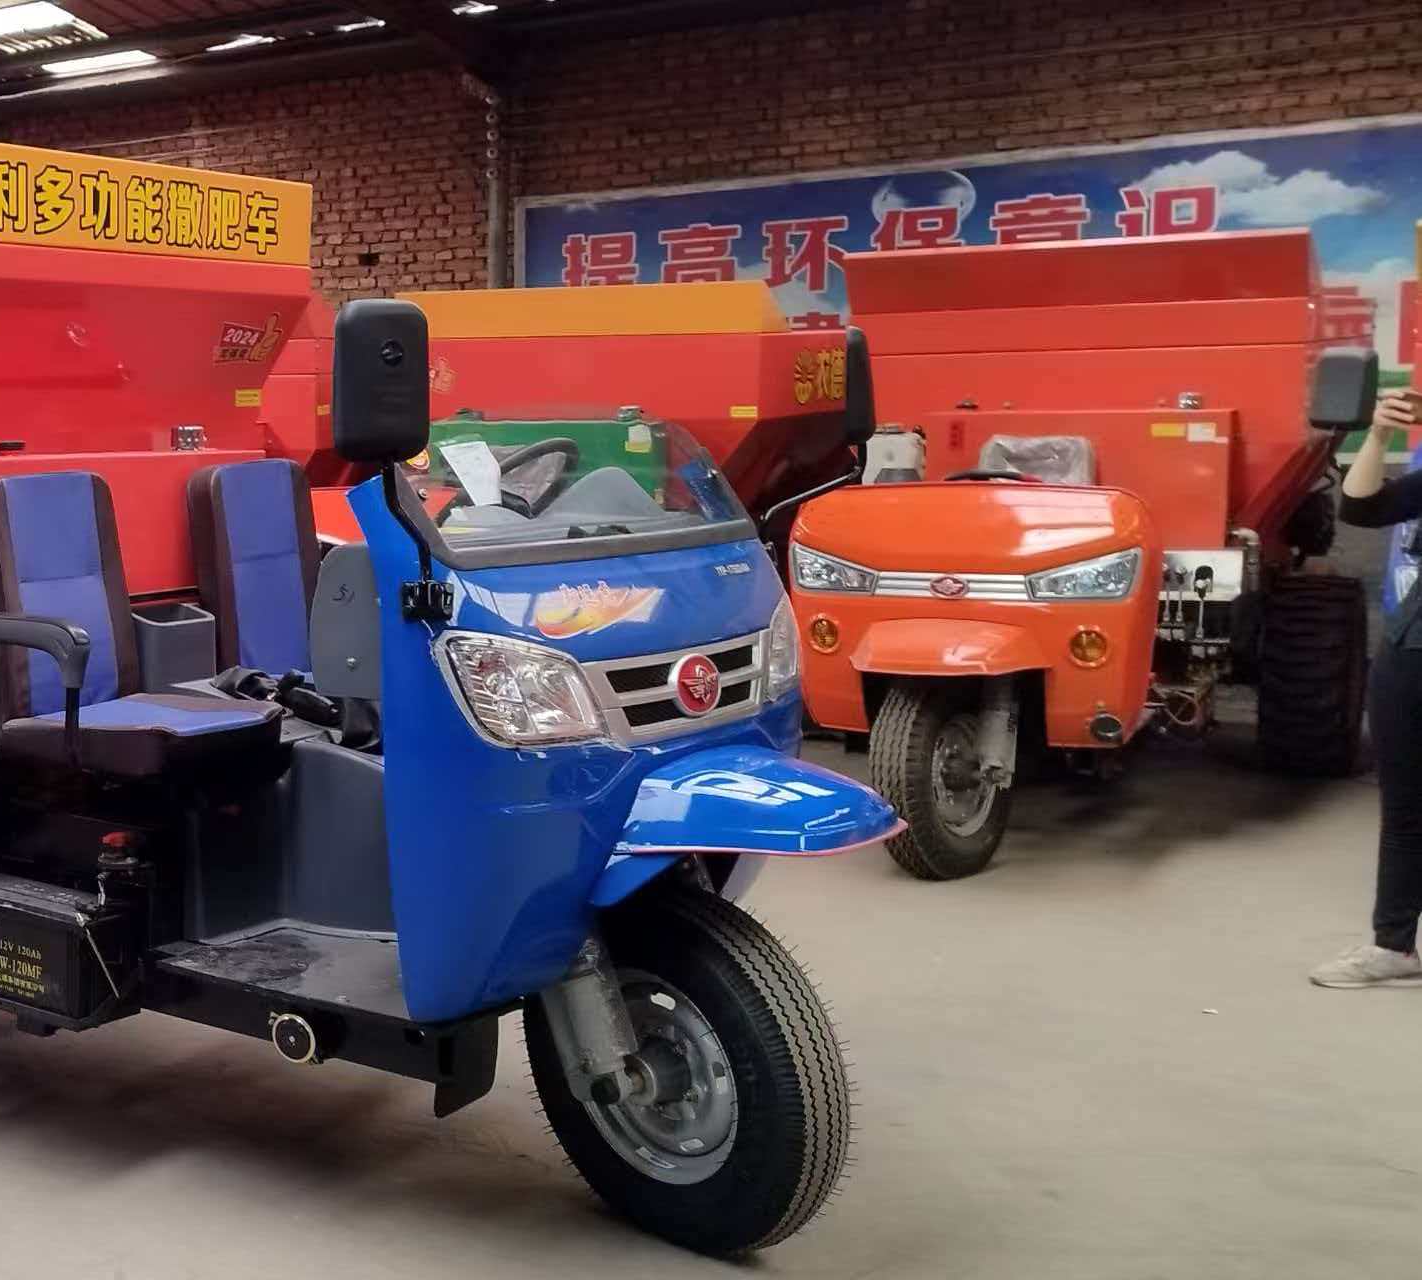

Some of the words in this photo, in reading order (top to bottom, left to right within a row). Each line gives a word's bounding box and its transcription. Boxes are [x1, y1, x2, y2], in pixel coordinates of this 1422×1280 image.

[223, 327, 259, 346] 2024
[0, 939, 14, 952] 12V
[18, 945, 42, 961] 120Ah
